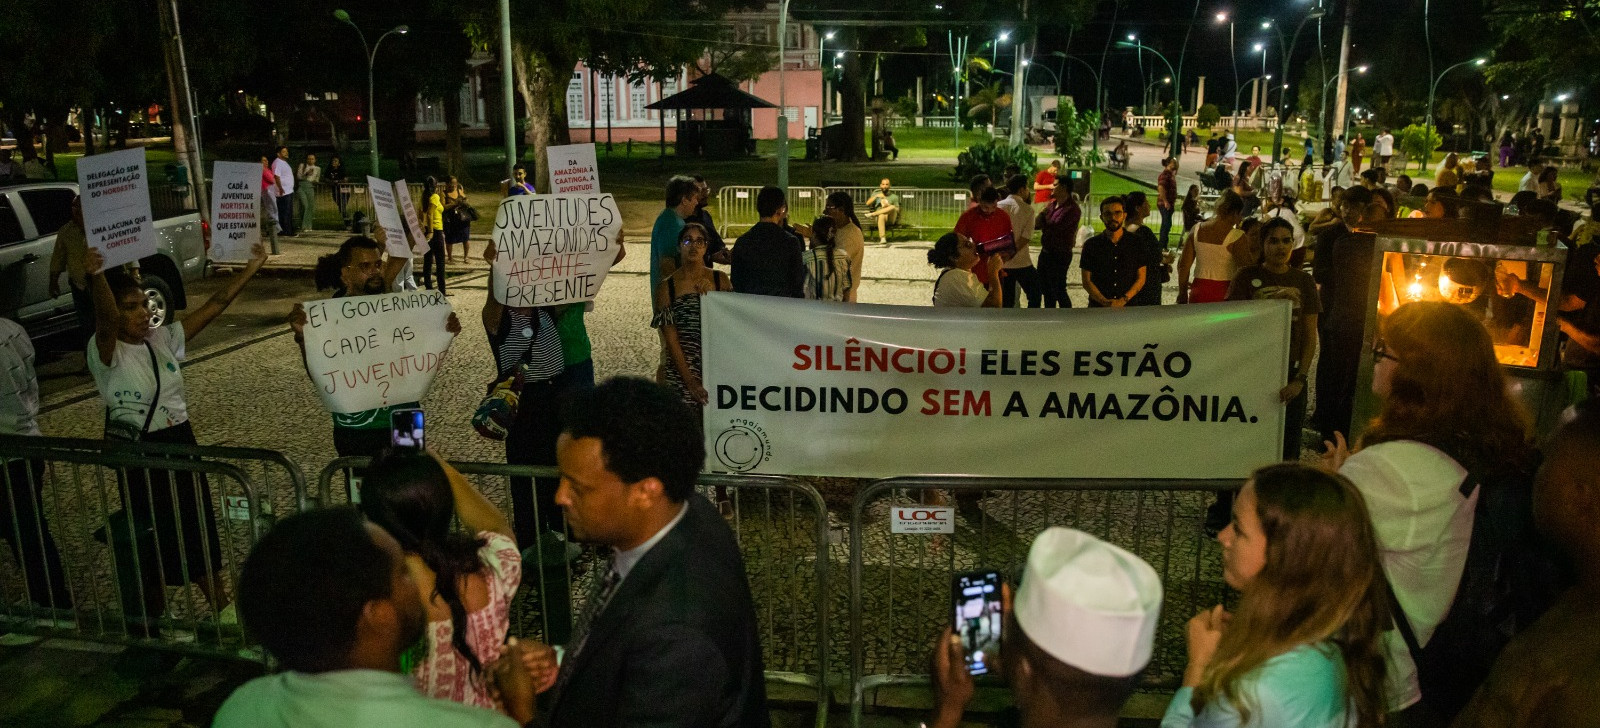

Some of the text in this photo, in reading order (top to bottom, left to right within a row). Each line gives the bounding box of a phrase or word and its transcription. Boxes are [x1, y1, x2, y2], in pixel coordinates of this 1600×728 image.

[87, 165, 139, 181] DELEGAÇÃO SEM
[554, 164, 594, 176] AMAZÔNIA À
[87, 173, 140, 190] REPRESENTAÇÃO
[227, 181, 243, 190] CADÊ
[559, 183, 594, 194] JUVENTUDE
[91, 184, 137, 198] DO NORDESTE:
[220, 202, 248, 210] NORTISTA
[495, 195, 614, 230] JUVENTUDES
[218, 212, 255, 220] NORDESTINA
[91, 215, 147, 235] UMA LACUNA QUE
[216, 222, 229, 231] QUE
[101, 226, 142, 242] A JUVENTUDE
[228, 232, 246, 240] AQUI?
[495, 225, 609, 262] AMAZONIDAS
[507, 252, 590, 287] AUSENTE
[505, 274, 597, 306] PRESENTE
[322, 326, 415, 359] CADÊ AS
[791, 337, 1192, 379] SILÊNCIO! ELES ESTÃO
[377, 381, 390, 405] ?
[716, 384, 1258, 424] DECIDINDO SEM A AMAZÔNIA.
[729, 418, 773, 462] engajamundo
[898, 510, 947, 520] LOC
